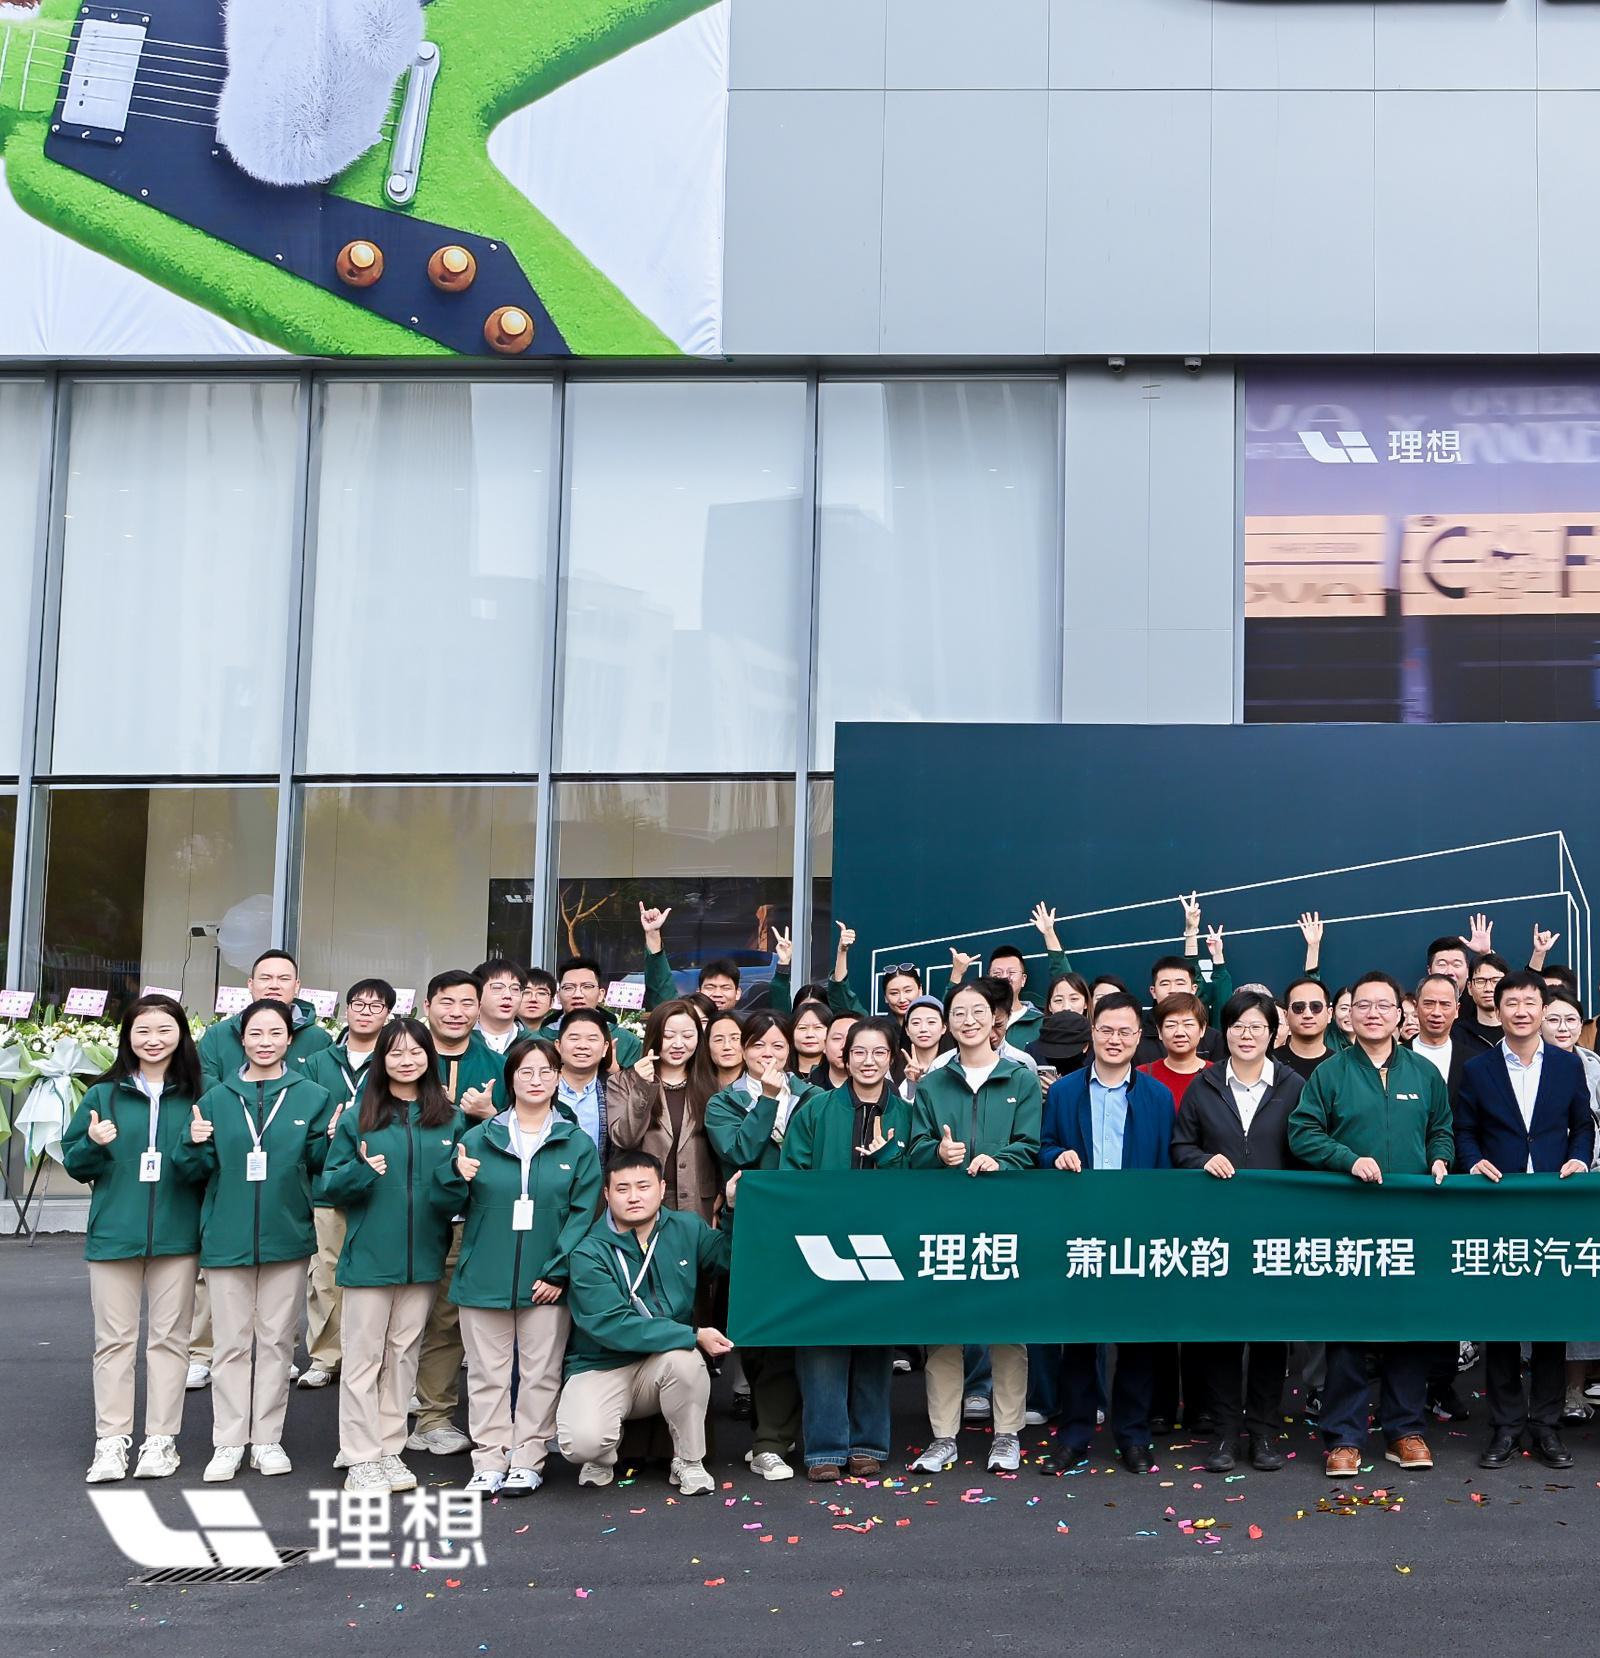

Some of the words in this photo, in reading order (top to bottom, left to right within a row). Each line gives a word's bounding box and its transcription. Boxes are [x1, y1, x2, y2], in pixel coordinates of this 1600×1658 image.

[1388, 430, 1462, 463] 理想
[917, 1233, 1020, 1281] 理想
[1065, 1236, 1229, 1279] 萧山秋韵
[1252, 1236, 1416, 1278] 理想新程
